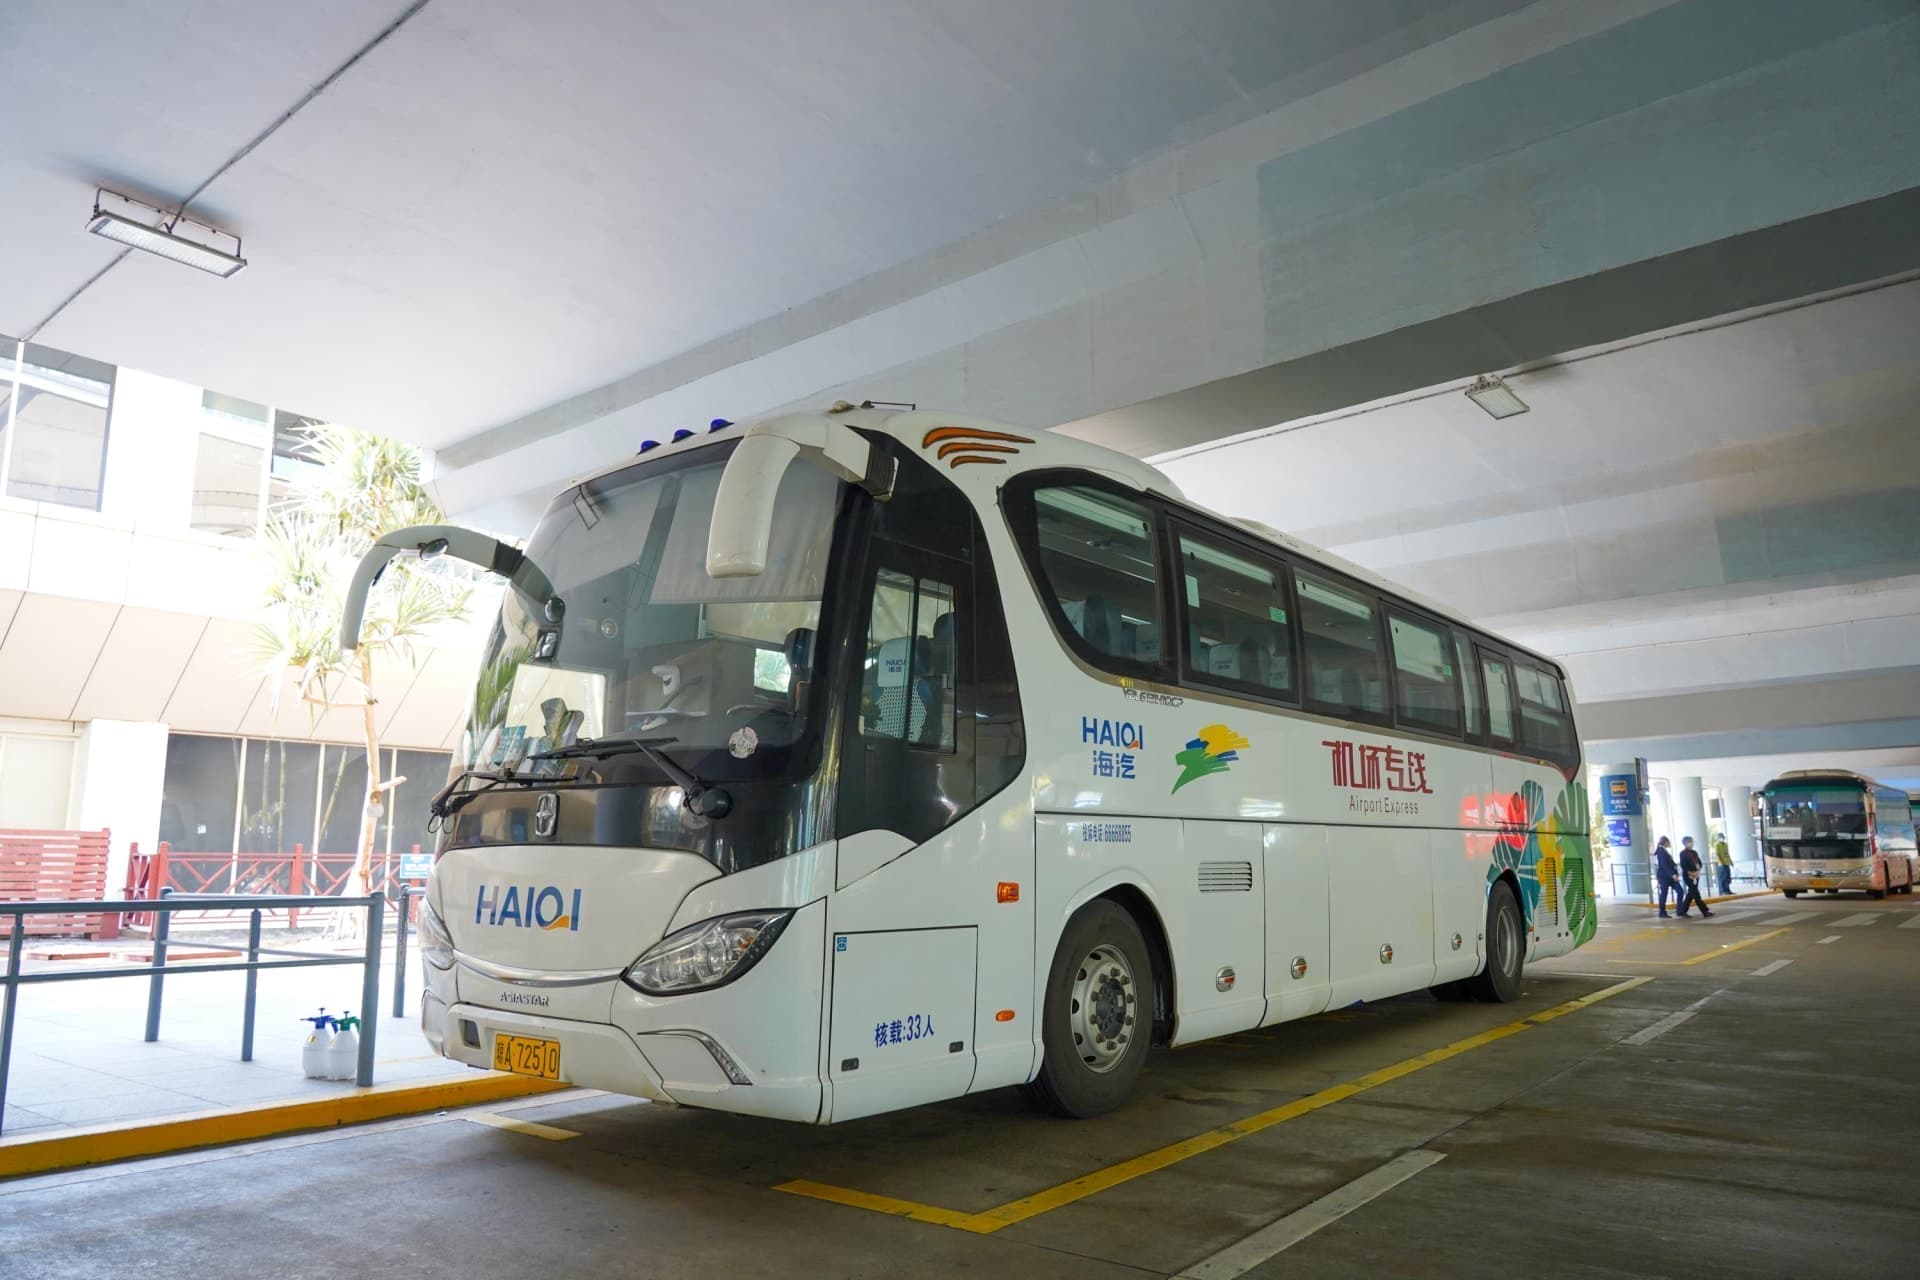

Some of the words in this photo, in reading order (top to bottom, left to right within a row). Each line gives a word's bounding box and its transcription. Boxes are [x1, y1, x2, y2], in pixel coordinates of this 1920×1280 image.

[1082, 716, 1143, 750] HAIQI
[1093, 749, 1136, 779] 海汽
[1322, 740, 1433, 793] 机场专线
[1349, 796, 1382, 815] Airport
[1384, 797, 1418, 816] Express
[475, 885, 582, 931] HAIQI
[500, 991, 550, 1007] ASIASTAR
